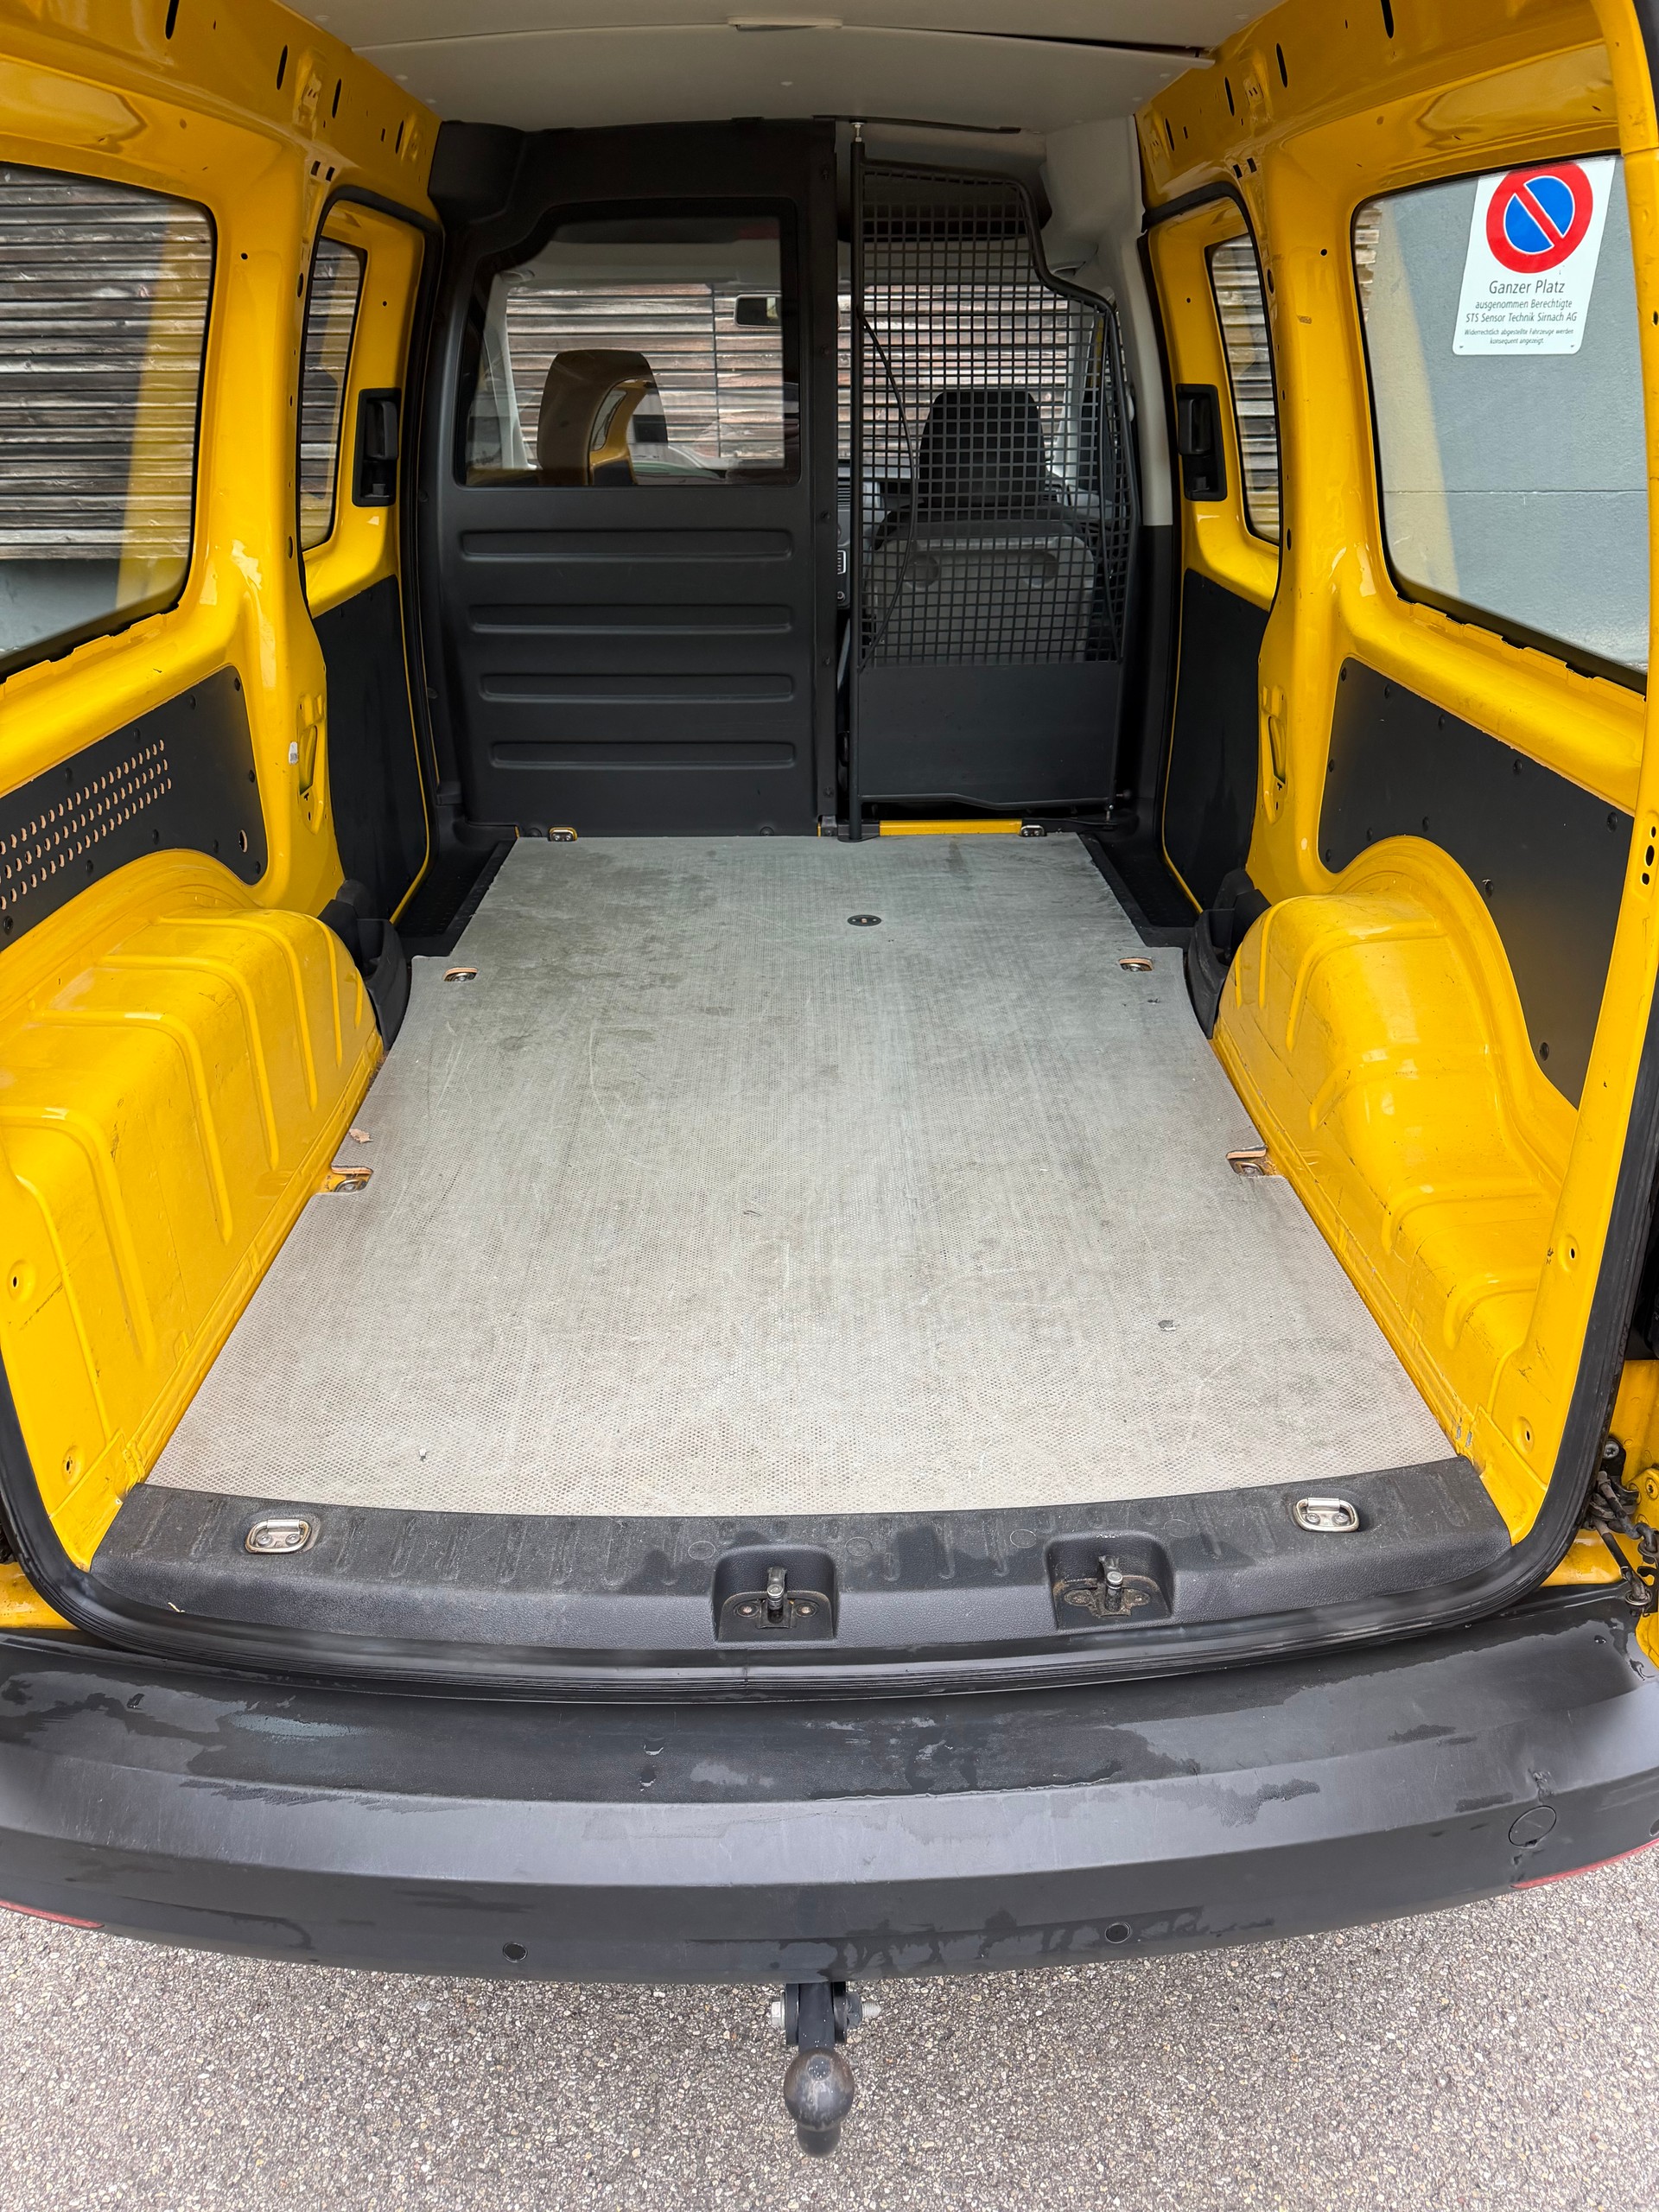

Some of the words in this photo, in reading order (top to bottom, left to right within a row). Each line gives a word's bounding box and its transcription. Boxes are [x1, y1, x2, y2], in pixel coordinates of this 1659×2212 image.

[1489, 280, 1531, 294] Ganzer
[1535, 279, 1566, 294] Platz
[1475, 300, 1529, 311] ausgenommen
[1530, 298, 1573, 311] Berechtigte
[1465, 313, 1479, 323] STS
[1481, 313, 1506, 323] Sensor
[1508, 312, 1535, 322] Technik
[1536, 312, 1565, 322] Sirnach
[1566, 312, 1578, 322] AG
